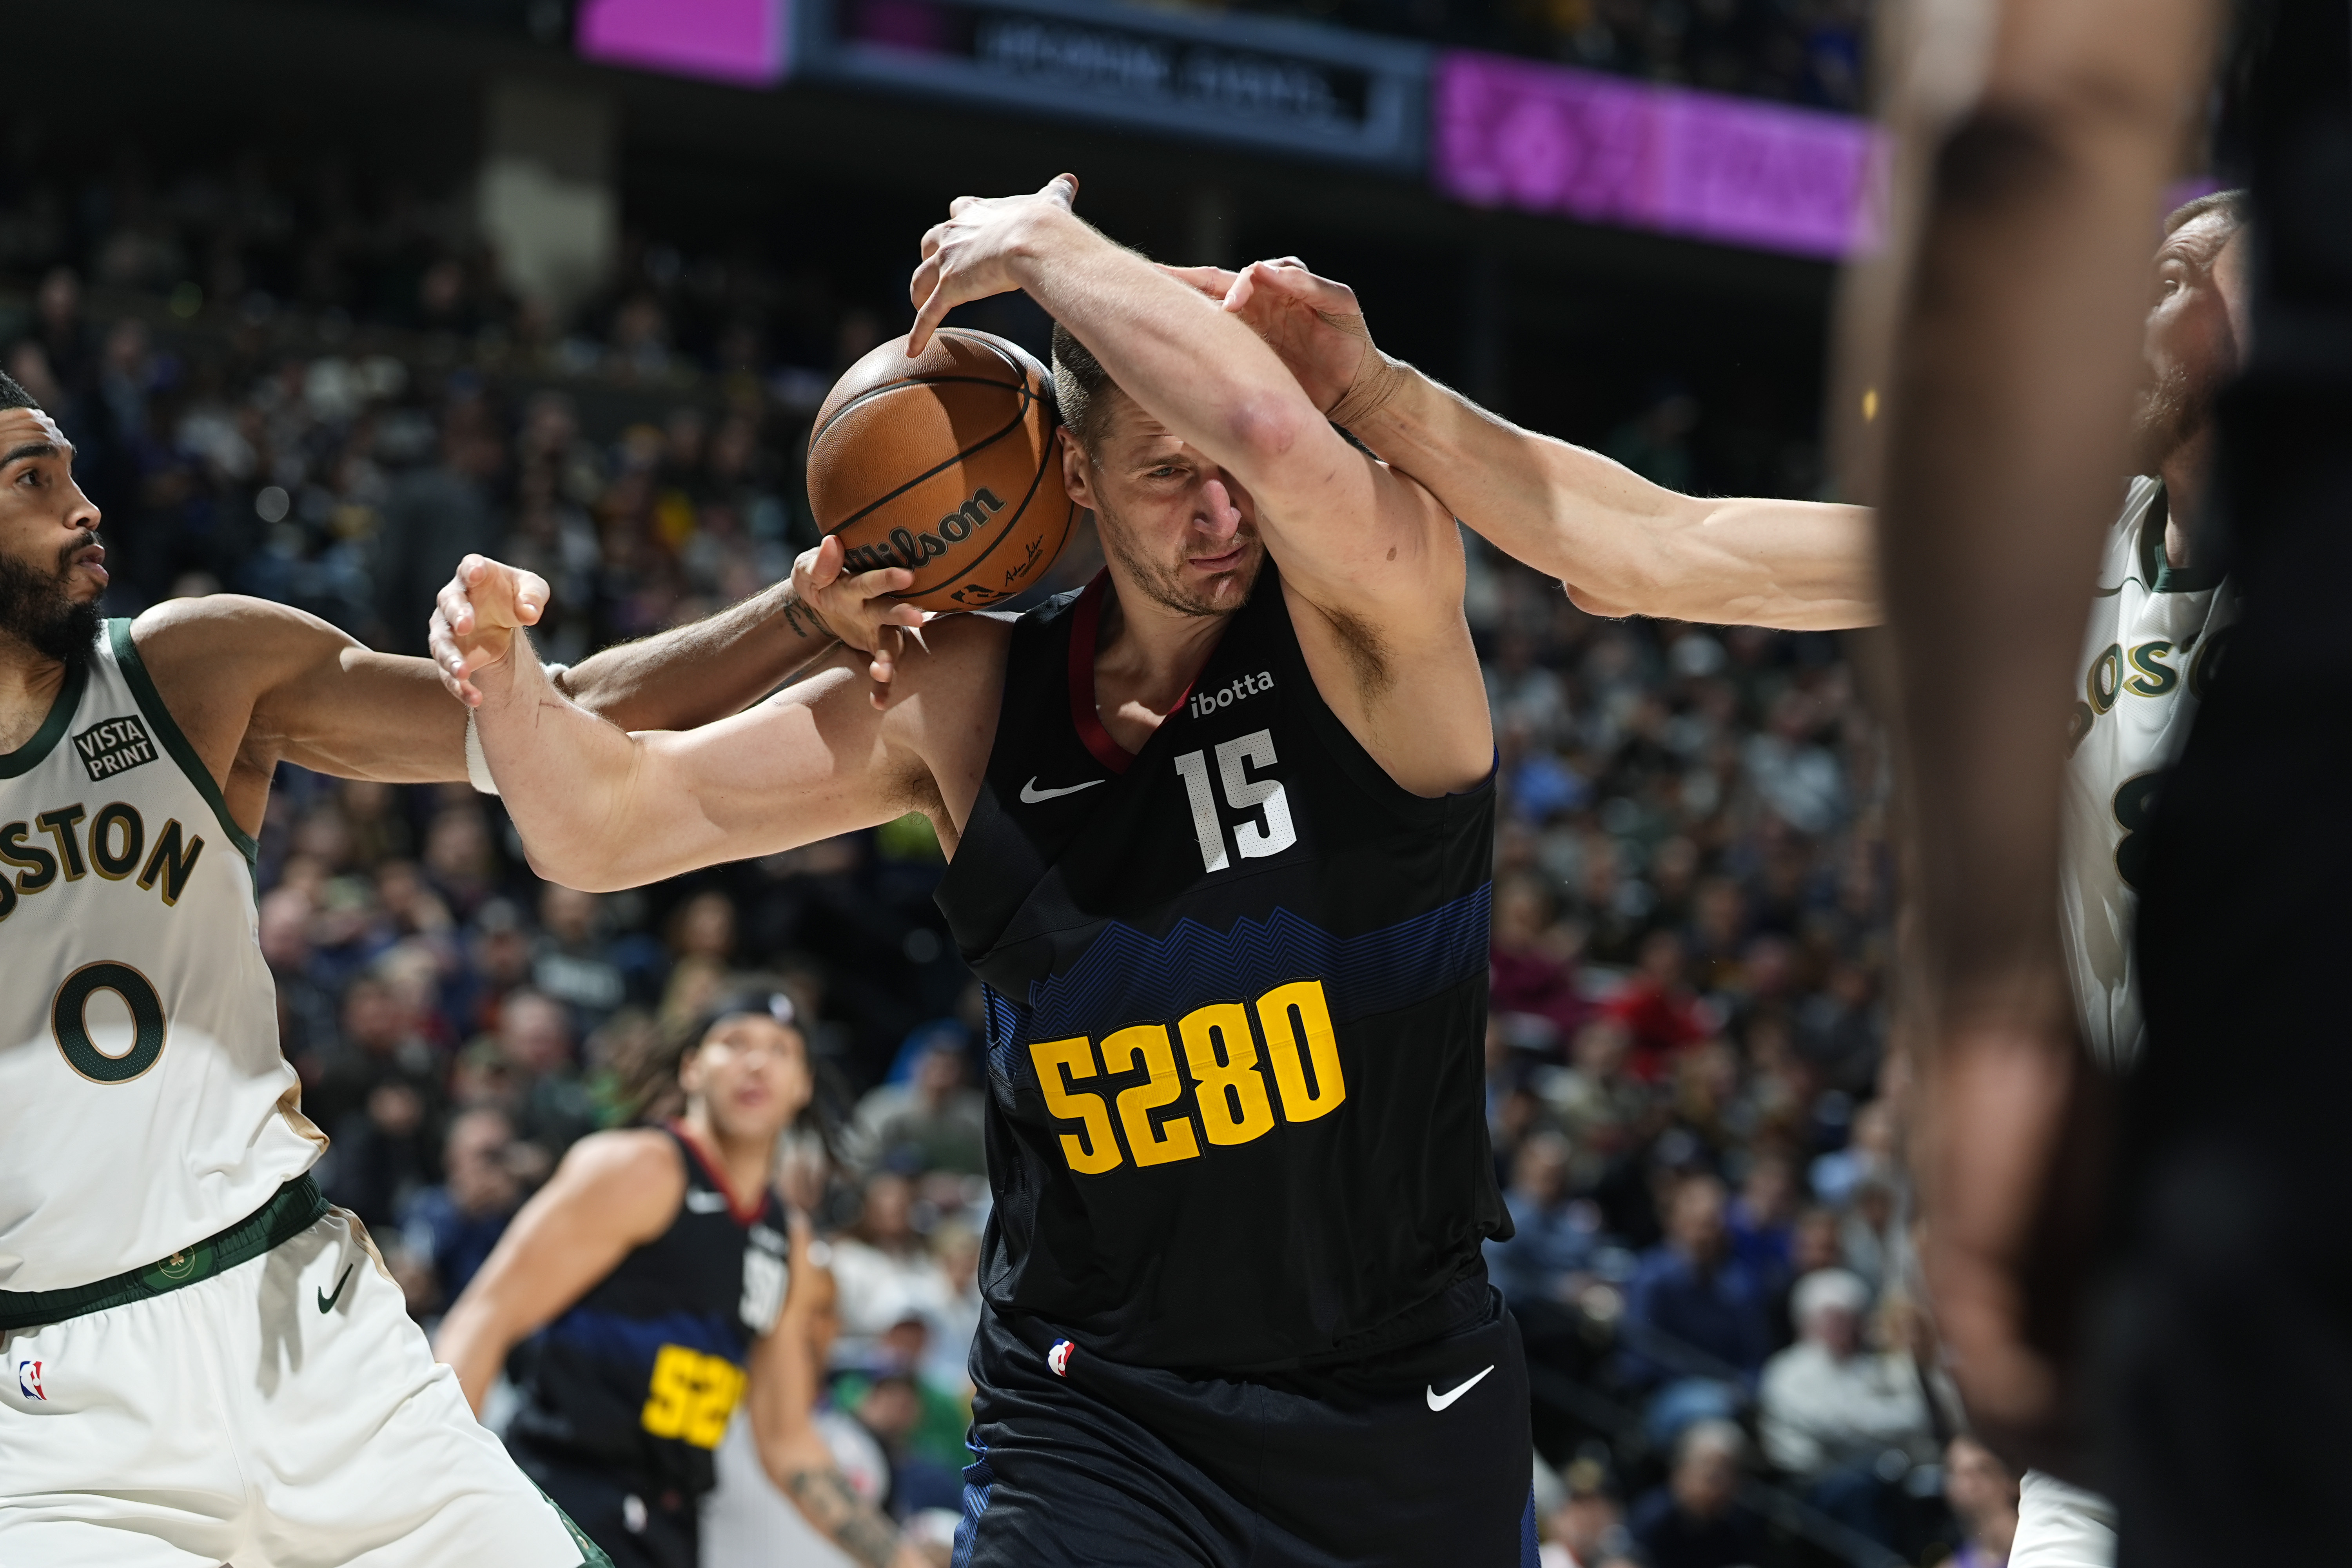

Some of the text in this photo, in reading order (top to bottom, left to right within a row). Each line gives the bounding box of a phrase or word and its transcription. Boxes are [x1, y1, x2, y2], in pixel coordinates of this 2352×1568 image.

[78, 719, 145, 758] VISTA
[1190, 670, 1275, 719] ibotta
[88, 740, 152, 779] PRINT
[1174, 728, 1297, 873] 15
[0, 801, 205, 922] STON
[51, 960, 167, 1085] 0
[1029, 978, 1346, 1175] 5280
[640, 1344, 747, 1450] 52
